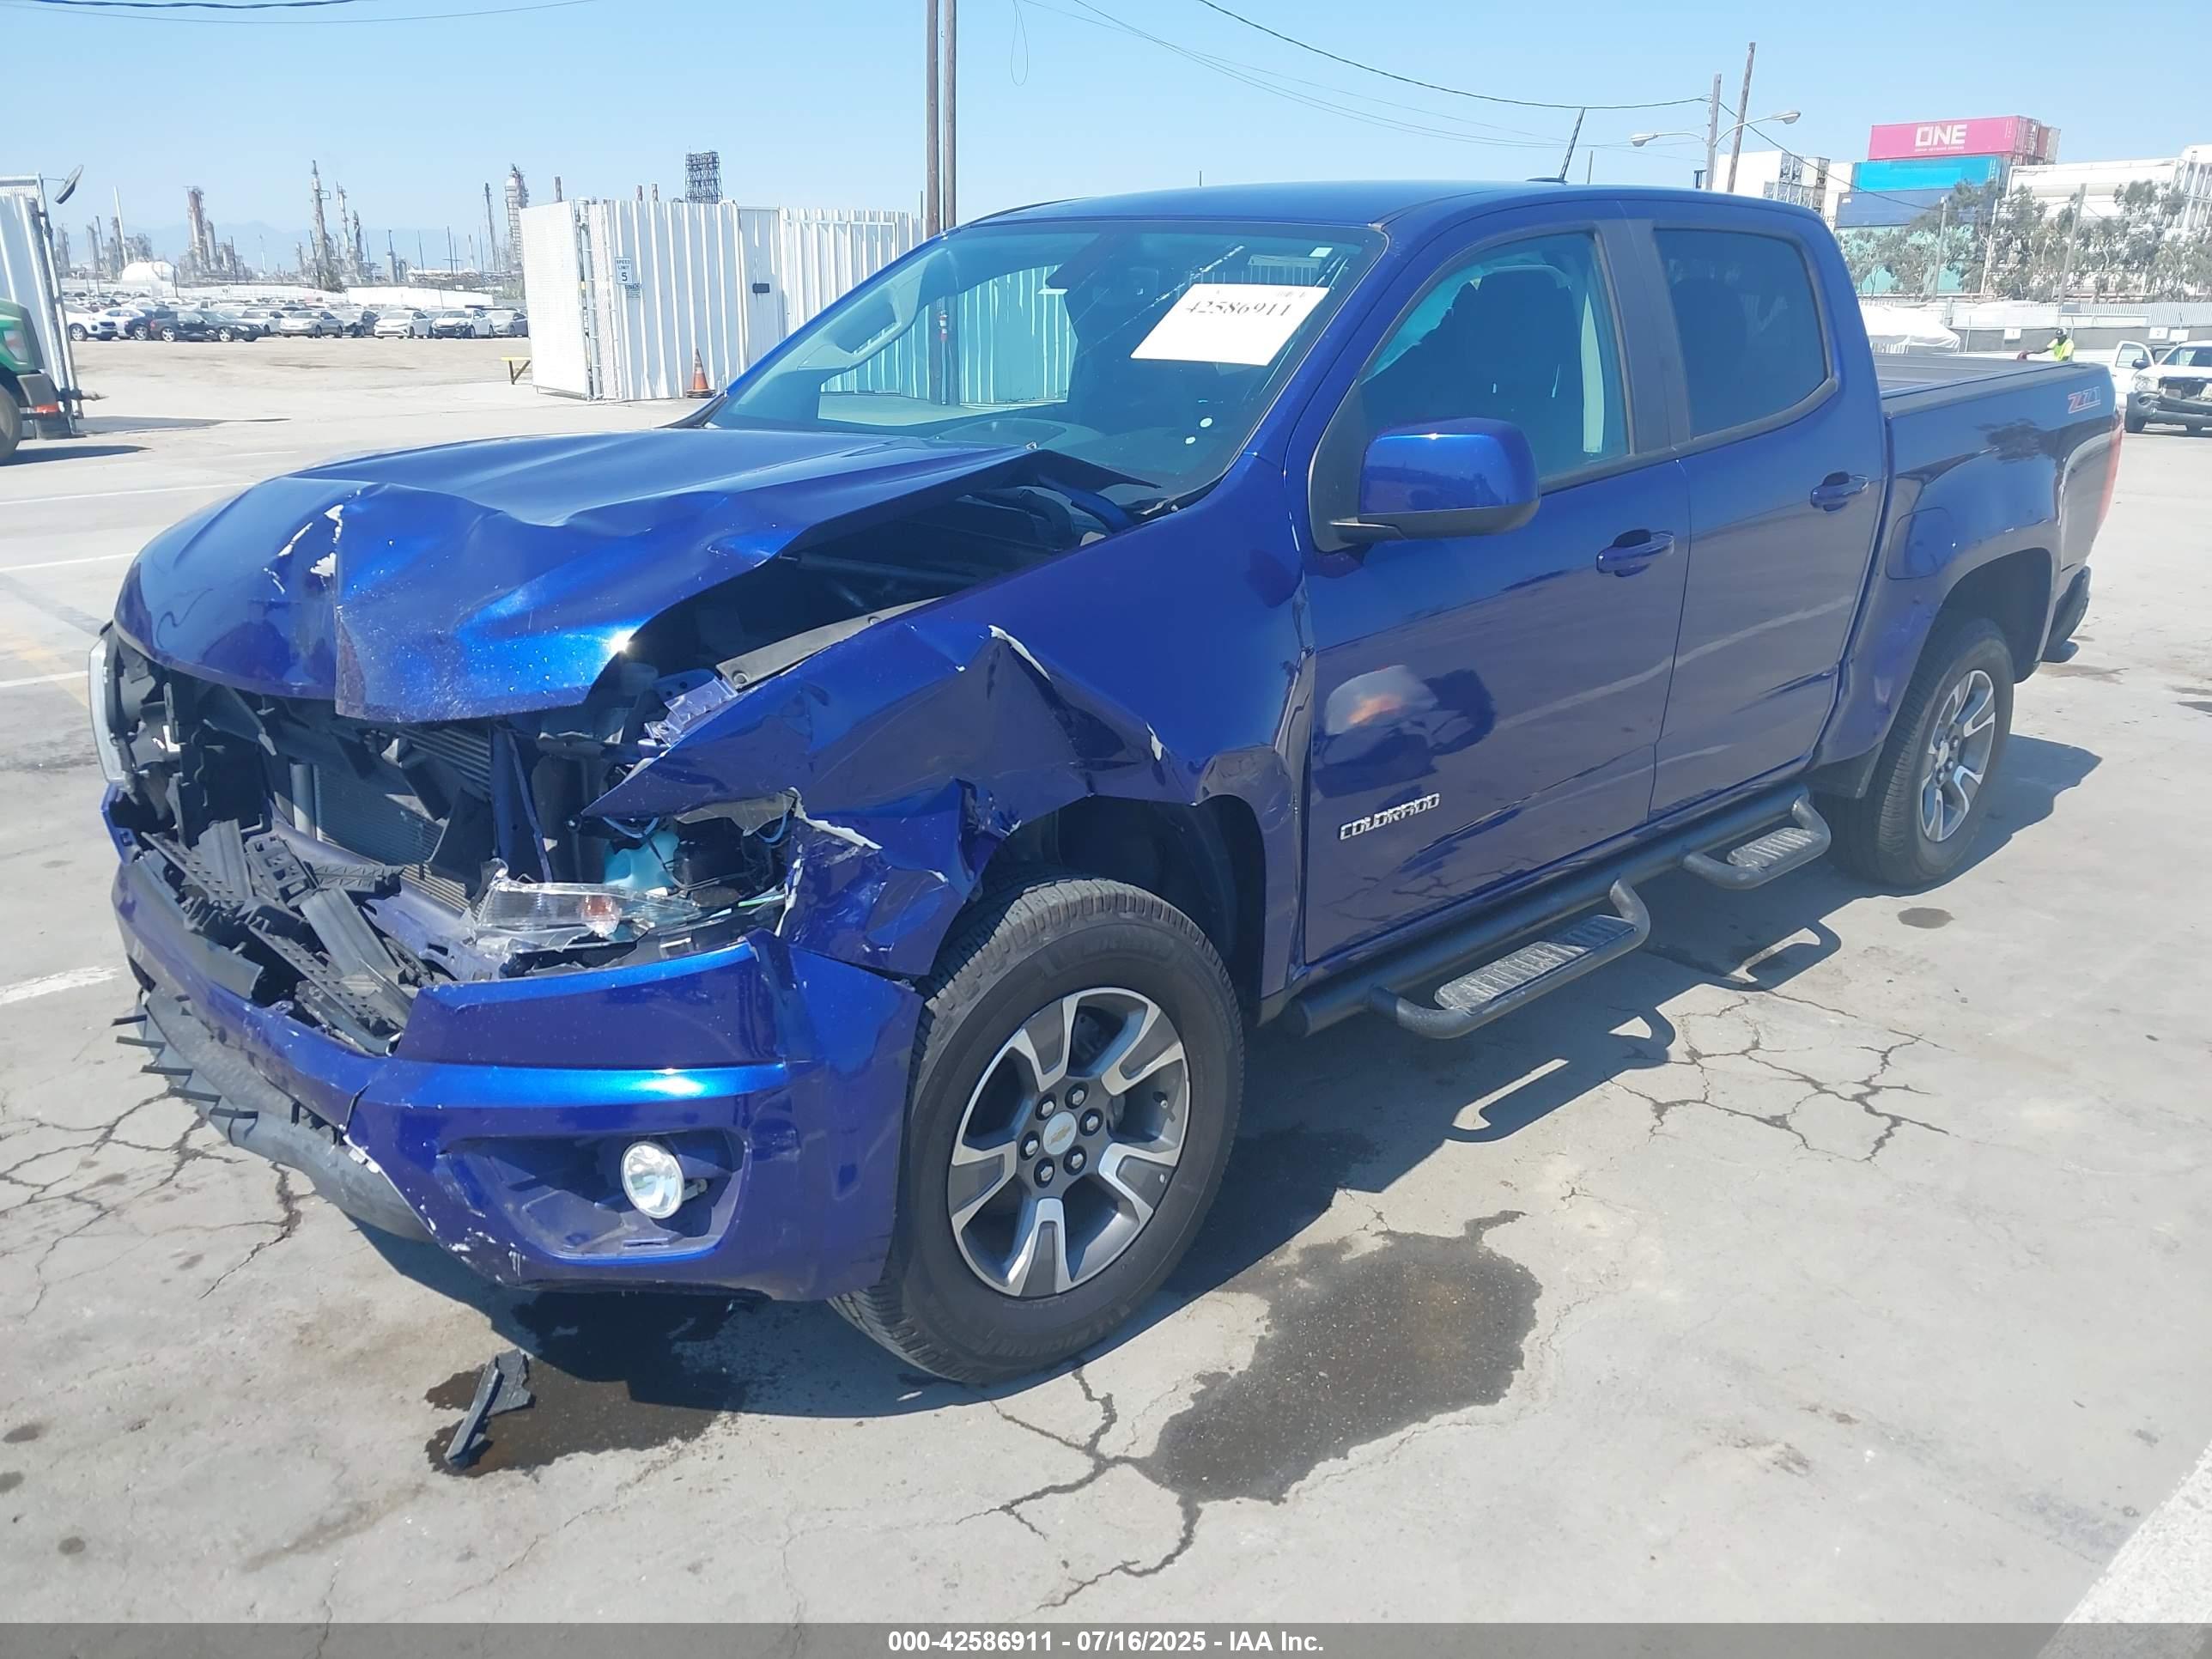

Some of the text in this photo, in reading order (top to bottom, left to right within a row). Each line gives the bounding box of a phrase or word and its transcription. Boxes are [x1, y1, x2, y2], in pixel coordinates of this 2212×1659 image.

[1915, 124, 1968, 147] ONE
[621, 271, 628, 282] 5
[1186, 301, 1291, 316] 42586911
[2068, 386, 2101, 414] Z71
[1340, 793, 1440, 841] COLORADO
